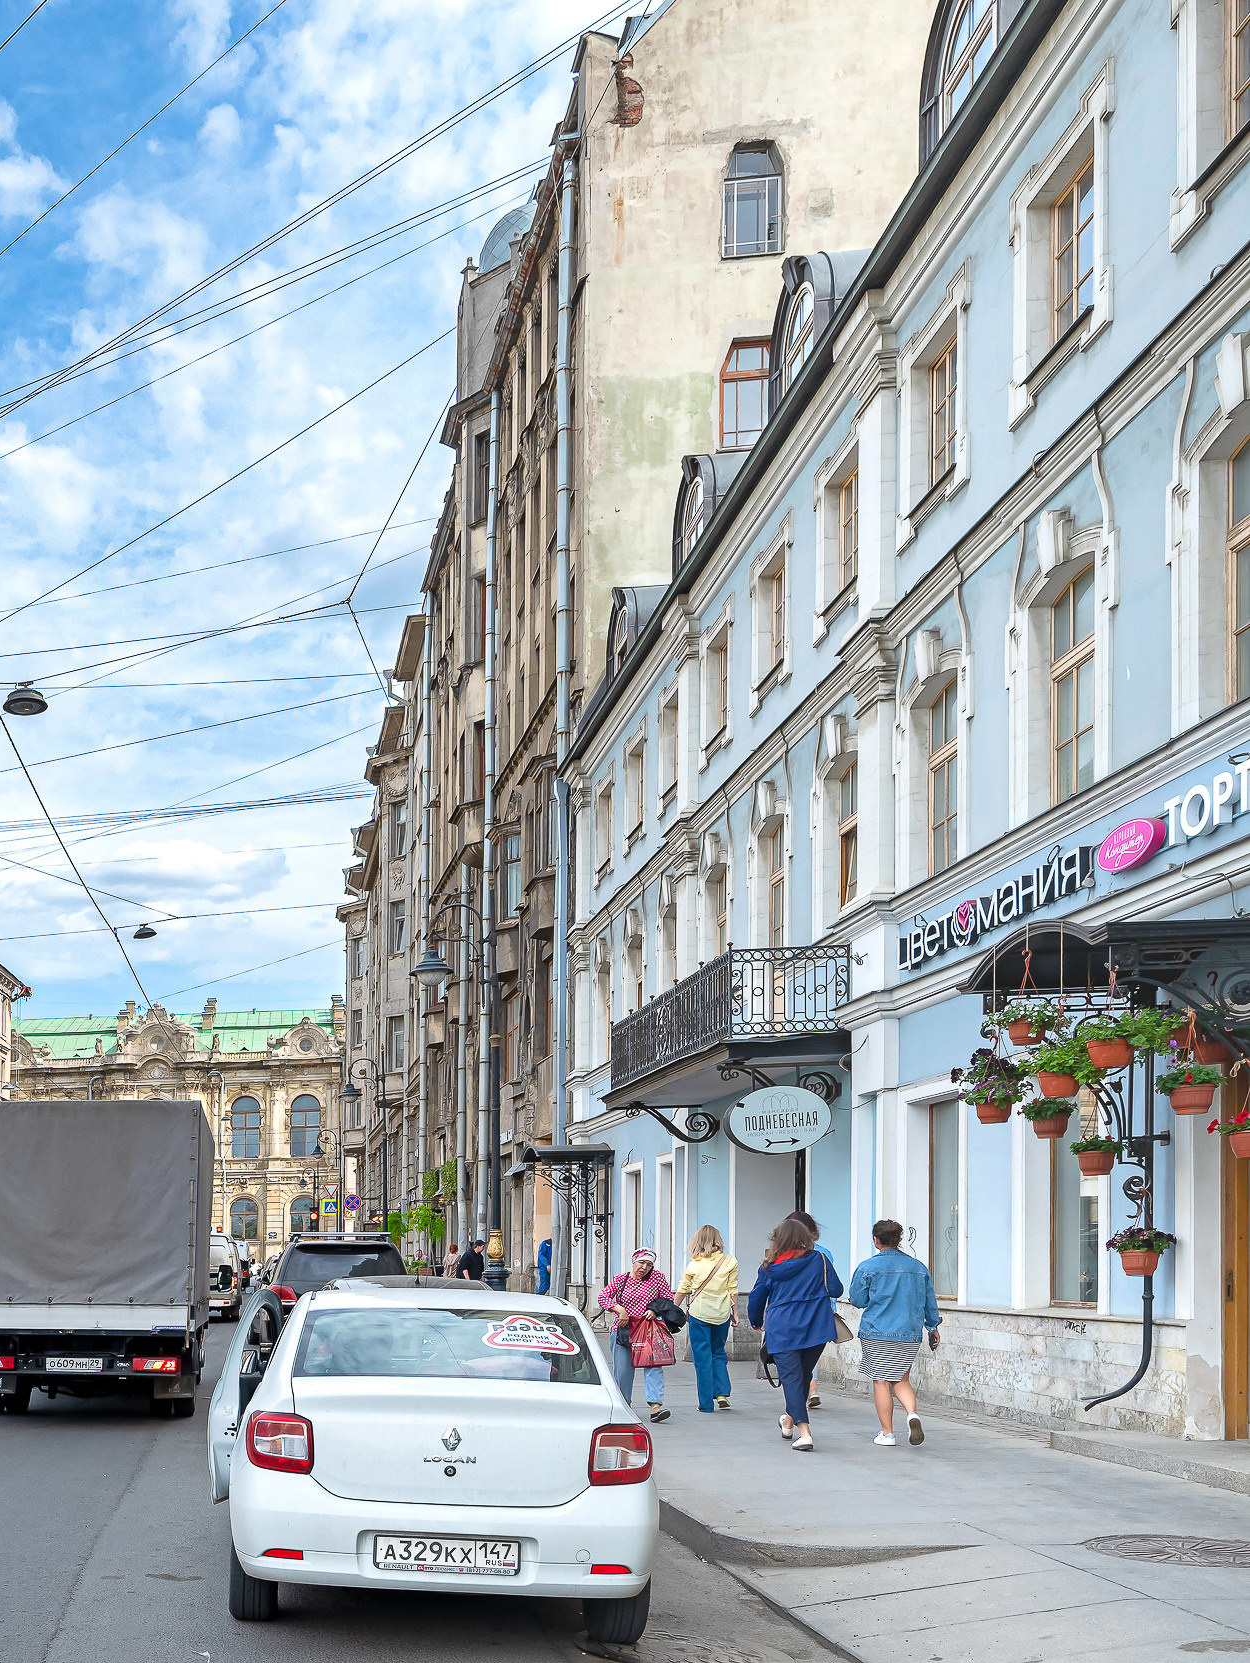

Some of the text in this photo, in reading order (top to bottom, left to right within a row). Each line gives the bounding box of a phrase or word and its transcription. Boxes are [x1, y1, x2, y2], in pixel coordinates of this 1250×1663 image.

[744, 1111, 819, 1131] ПОДНЕБЕСНАЯ
[492, 1323, 558, 1332] Радио
[49, 1359, 88, 1368] О609МН
[423, 1454, 477, 1464] LOGAN
[383, 1540, 512, 1564] А329КХ 147
[485, 1559, 503, 1567] RUS
